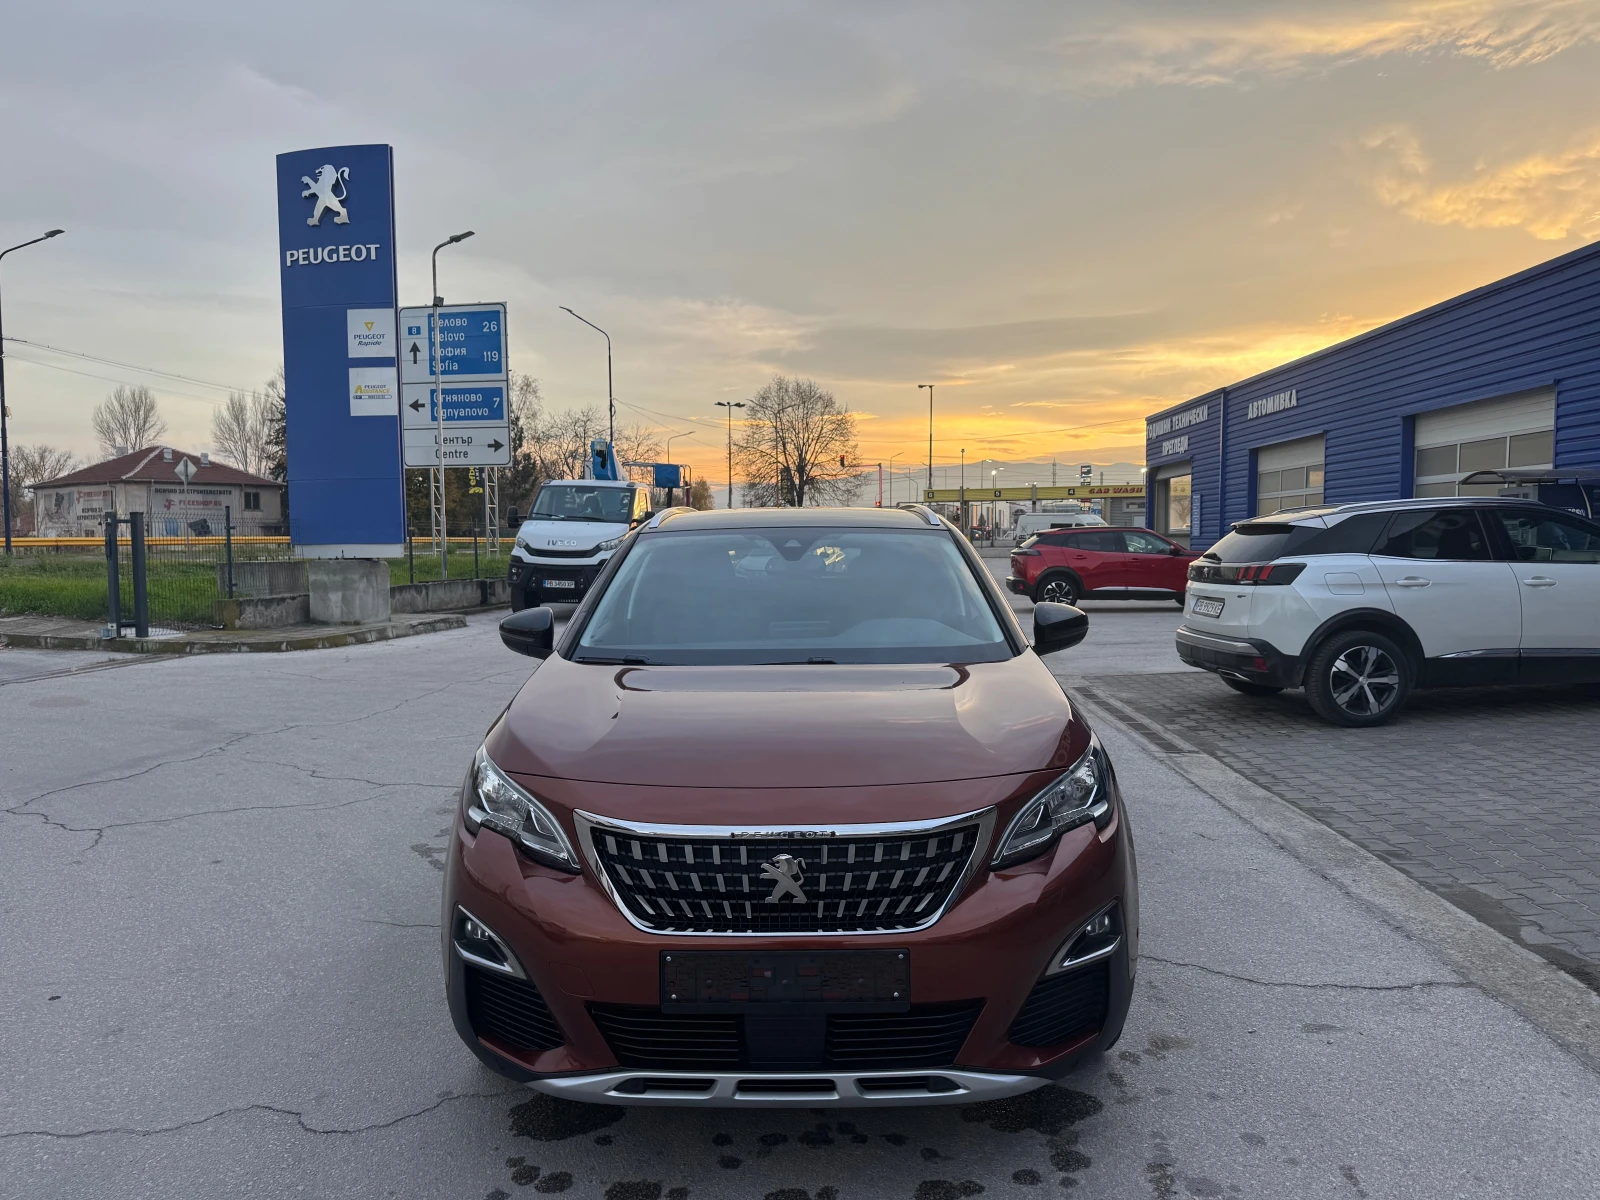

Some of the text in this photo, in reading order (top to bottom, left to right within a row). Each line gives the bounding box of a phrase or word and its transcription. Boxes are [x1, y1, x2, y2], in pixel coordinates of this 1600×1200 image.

[286, 244, 380, 267] PEUGEOT
[482, 321, 498, 332] 26
[483, 351, 499, 362] 119
[493, 397, 500, 408] 7
[1247, 389, 1297, 420] АВТОМИВКА
[1172, 404, 1208, 431] ТЕХНИЧЕСКИ
[1162, 435, 1189, 456] ПРЕГЛЕДИ
[1088, 487, 1110, 495] CAR
[741, 831, 828, 839] PEUGEOT
